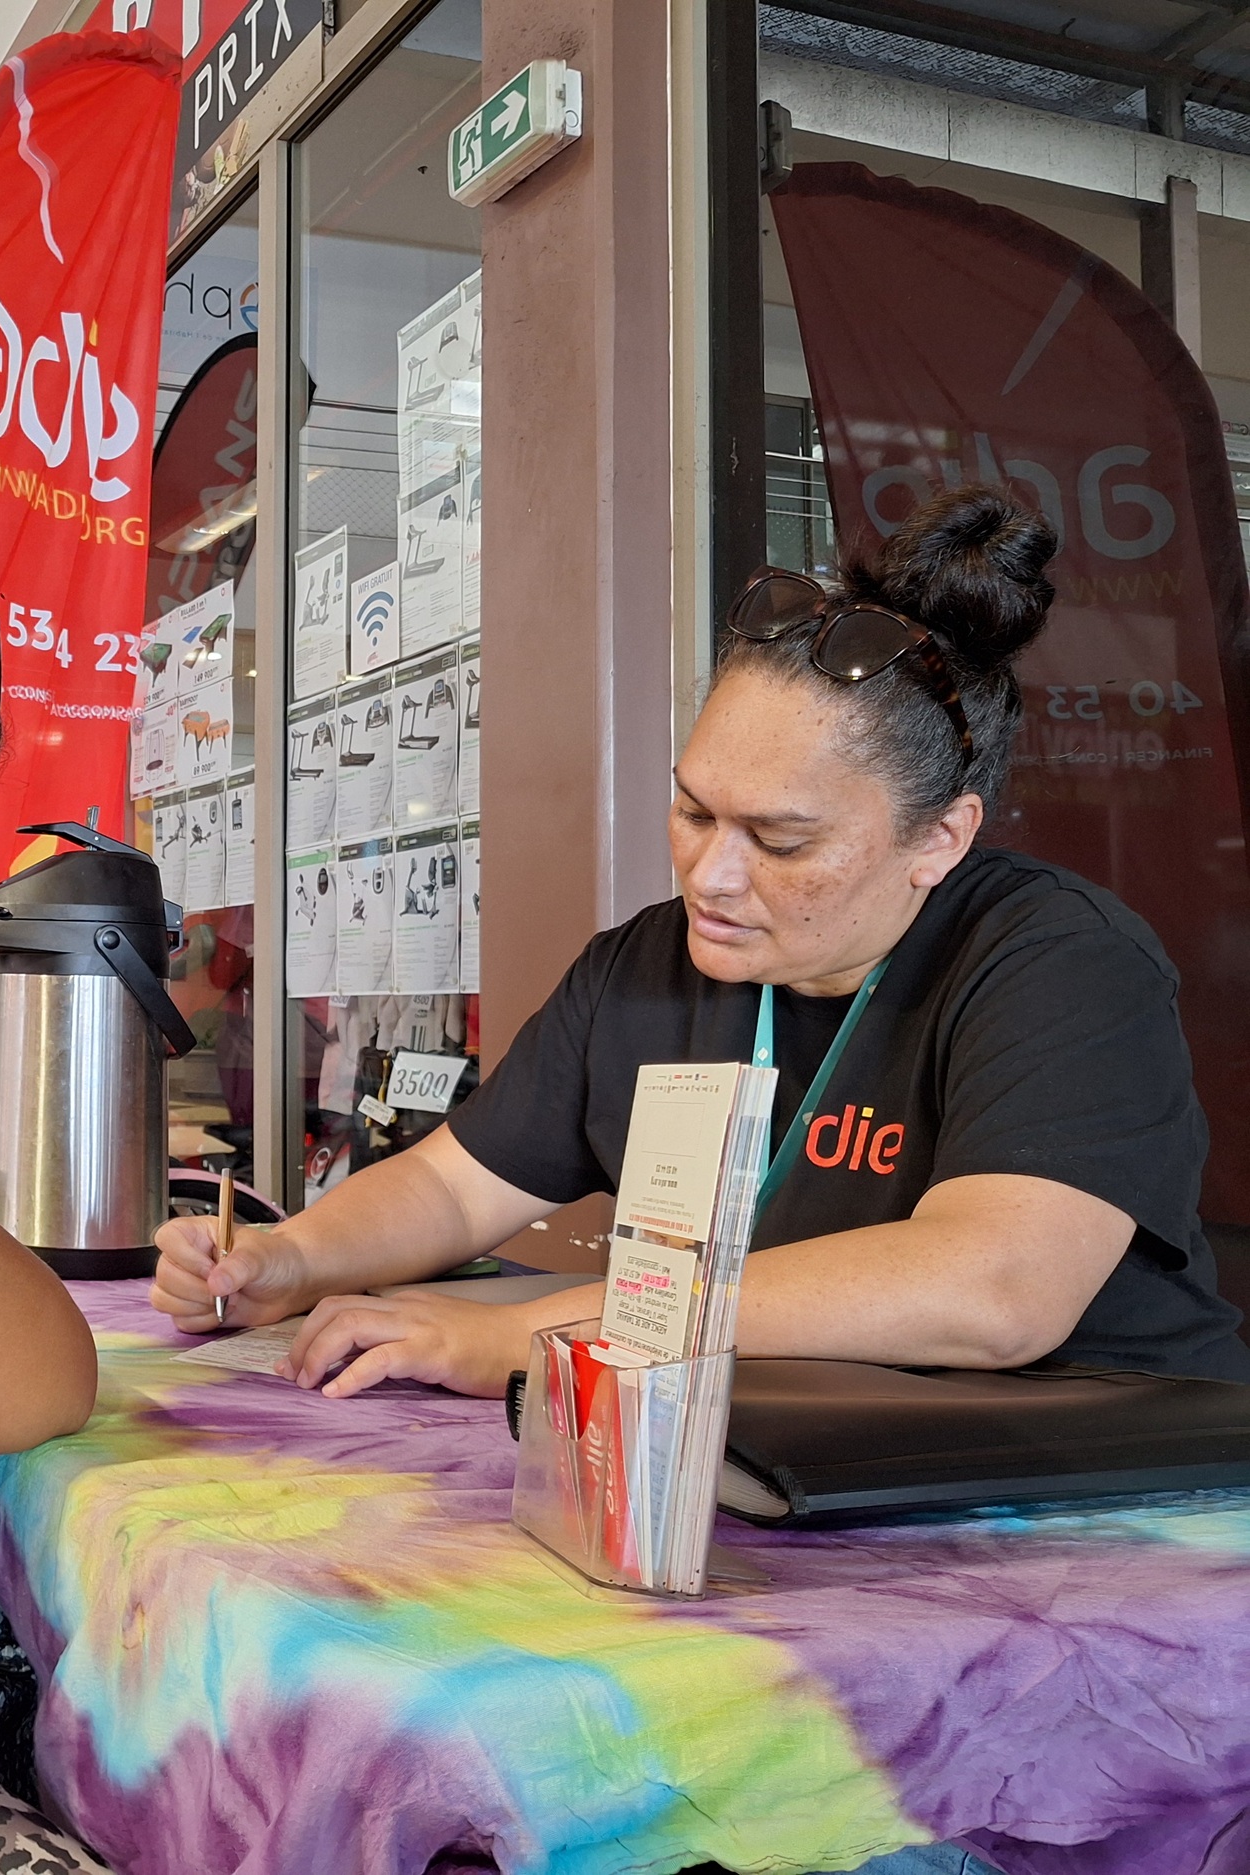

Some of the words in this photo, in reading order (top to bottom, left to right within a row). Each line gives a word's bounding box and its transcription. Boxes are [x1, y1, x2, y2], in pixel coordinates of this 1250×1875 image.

[193, 0, 293, 150] PRIX
[357, 582, 370, 595] WIFI
[370, 568, 394, 588] GRATUIT
[6, 602, 55, 651] 53
[393, 1068, 449, 1099] 3500
